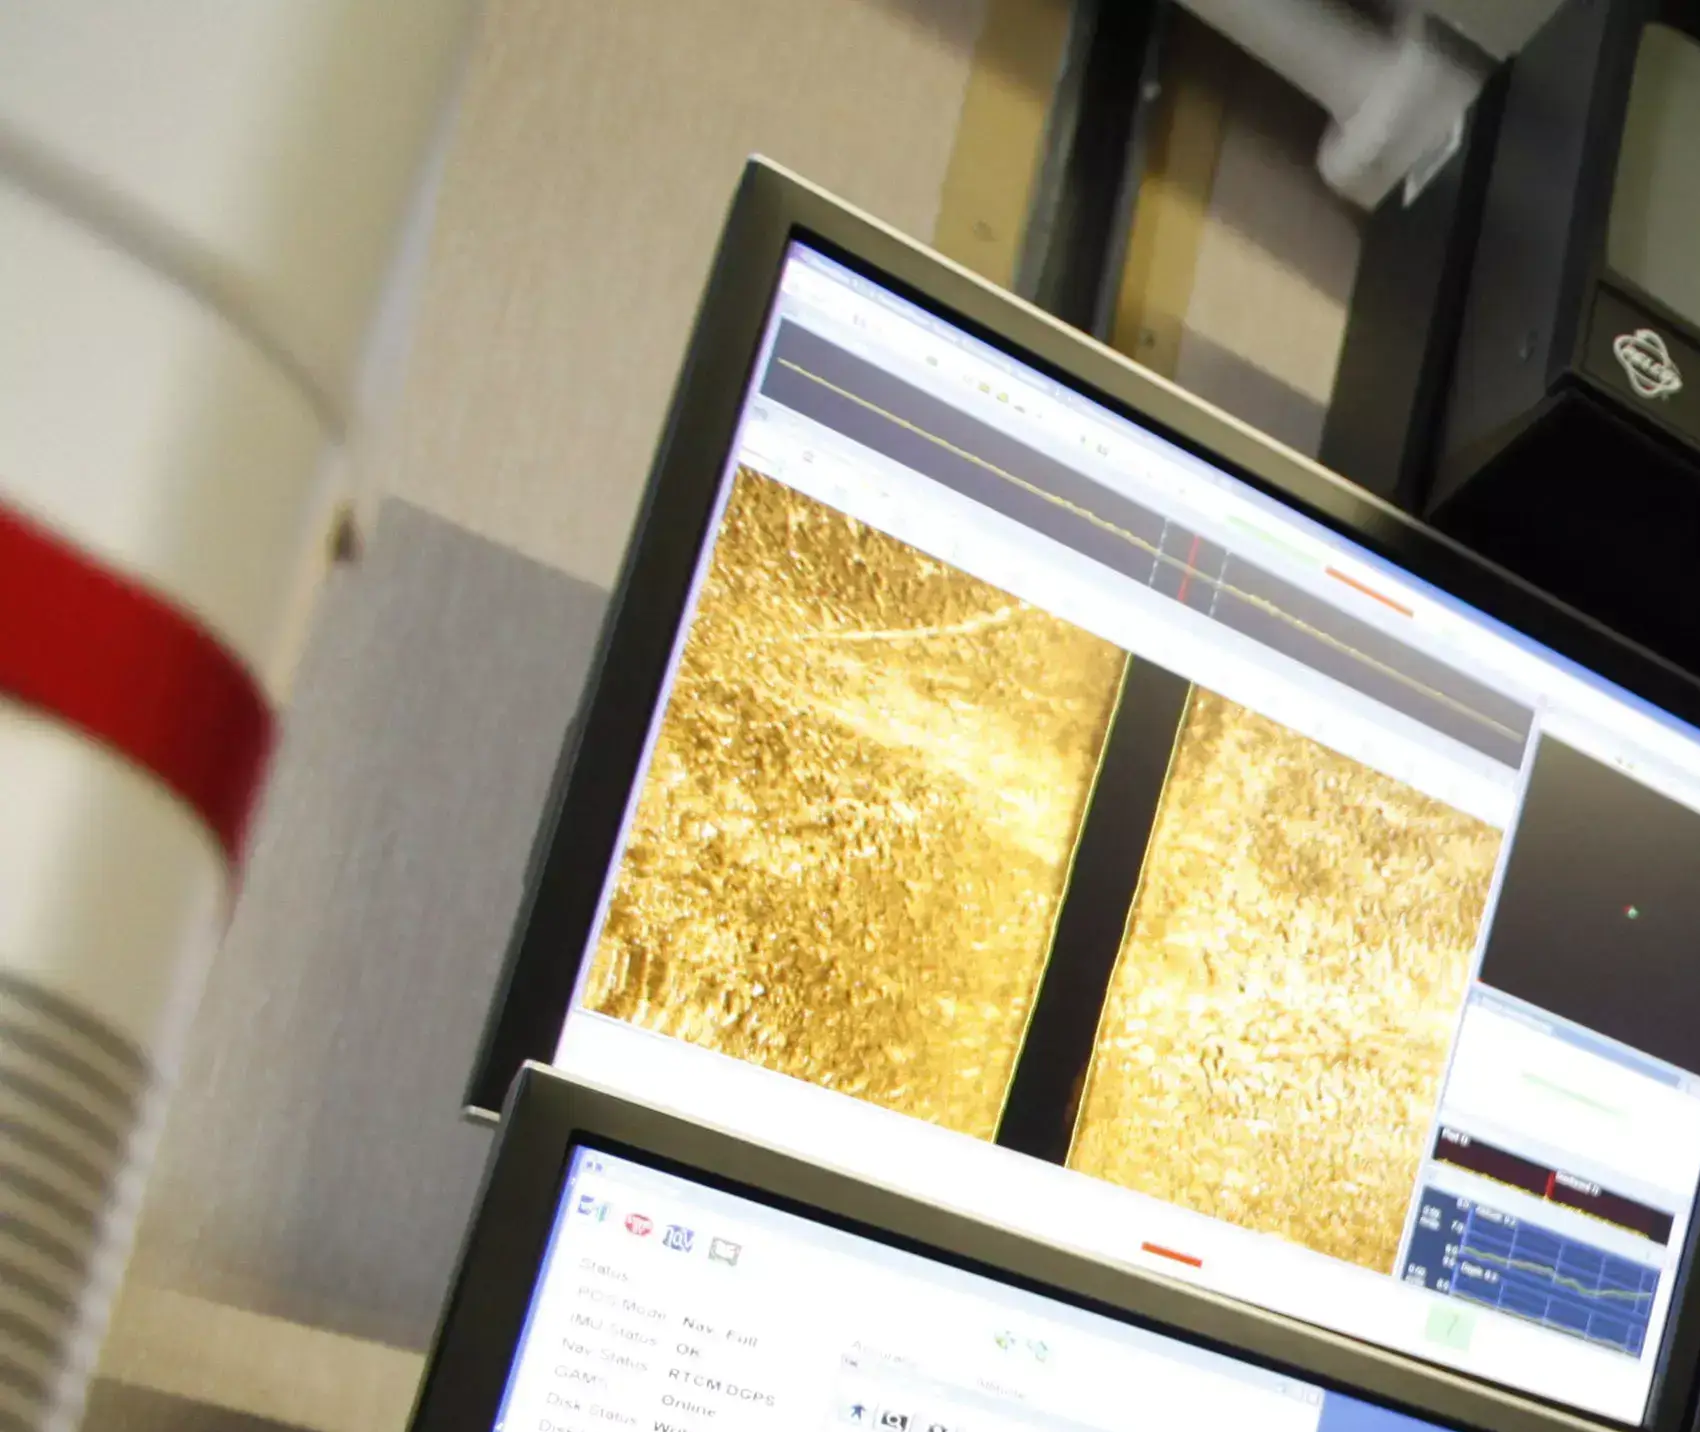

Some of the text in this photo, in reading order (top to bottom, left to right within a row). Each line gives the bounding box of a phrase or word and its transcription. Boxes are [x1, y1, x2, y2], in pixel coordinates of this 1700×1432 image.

[570, 1312, 658, 1348] IMU Status
[725, 1328, 759, 1350] Full
[562, 1336, 649, 1373] Nav Status
[676, 1342, 701, 1358] OK
[668, 1367, 776, 1408] RTCM DGPS
[546, 1391, 638, 1427] Disk Status
[661, 1394, 717, 1419] Online
